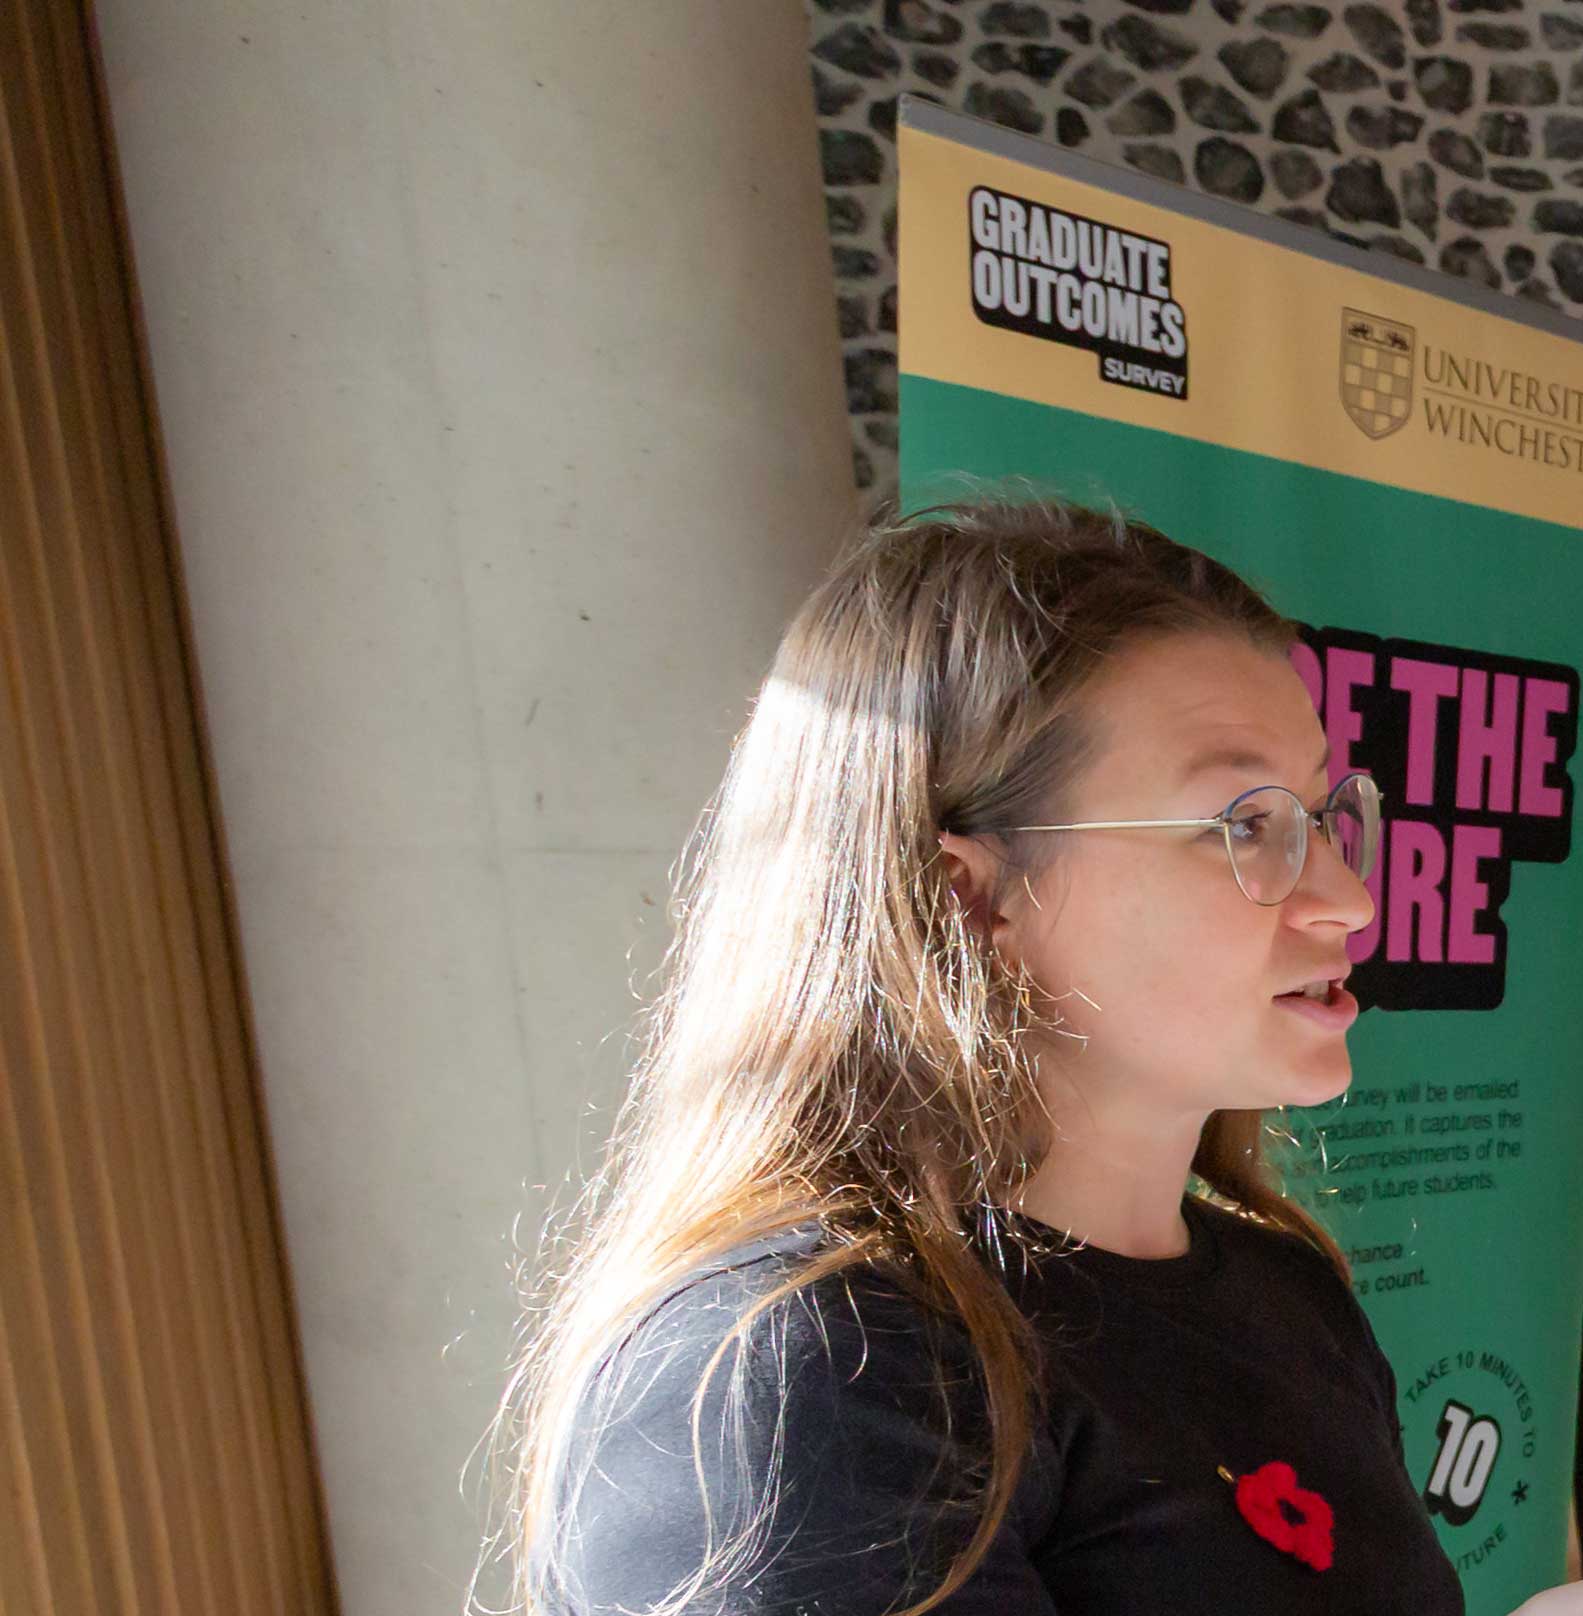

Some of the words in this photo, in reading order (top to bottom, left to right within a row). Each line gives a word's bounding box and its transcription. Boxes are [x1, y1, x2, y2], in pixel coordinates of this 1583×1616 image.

[971, 189, 1172, 299] GRADUATE
[971, 251, 1186, 360] OUTCOMES
[1104, 355, 1186, 395] SURVEY
[1390, 655, 1570, 818] THE
[1394, 1081, 1421, 1103] will
[1426, 1081, 1448, 1101] be
[1453, 1078, 1519, 1101] emailed
[1420, 1112, 1493, 1139] captures
[1497, 1108, 1523, 1129] the
[1476, 1138, 1494, 1159] of
[1496, 1138, 1521, 1160] the
[1372, 1176, 1418, 1201] future
[1404, 1356, 1450, 1404] TAKE
[1456, 1351, 1474, 1370] 10
[1479, 1351, 1533, 1423] MINUTES
[1522, 1429, 1537, 1459] TO
[1427, 1403, 1501, 1509] 10
